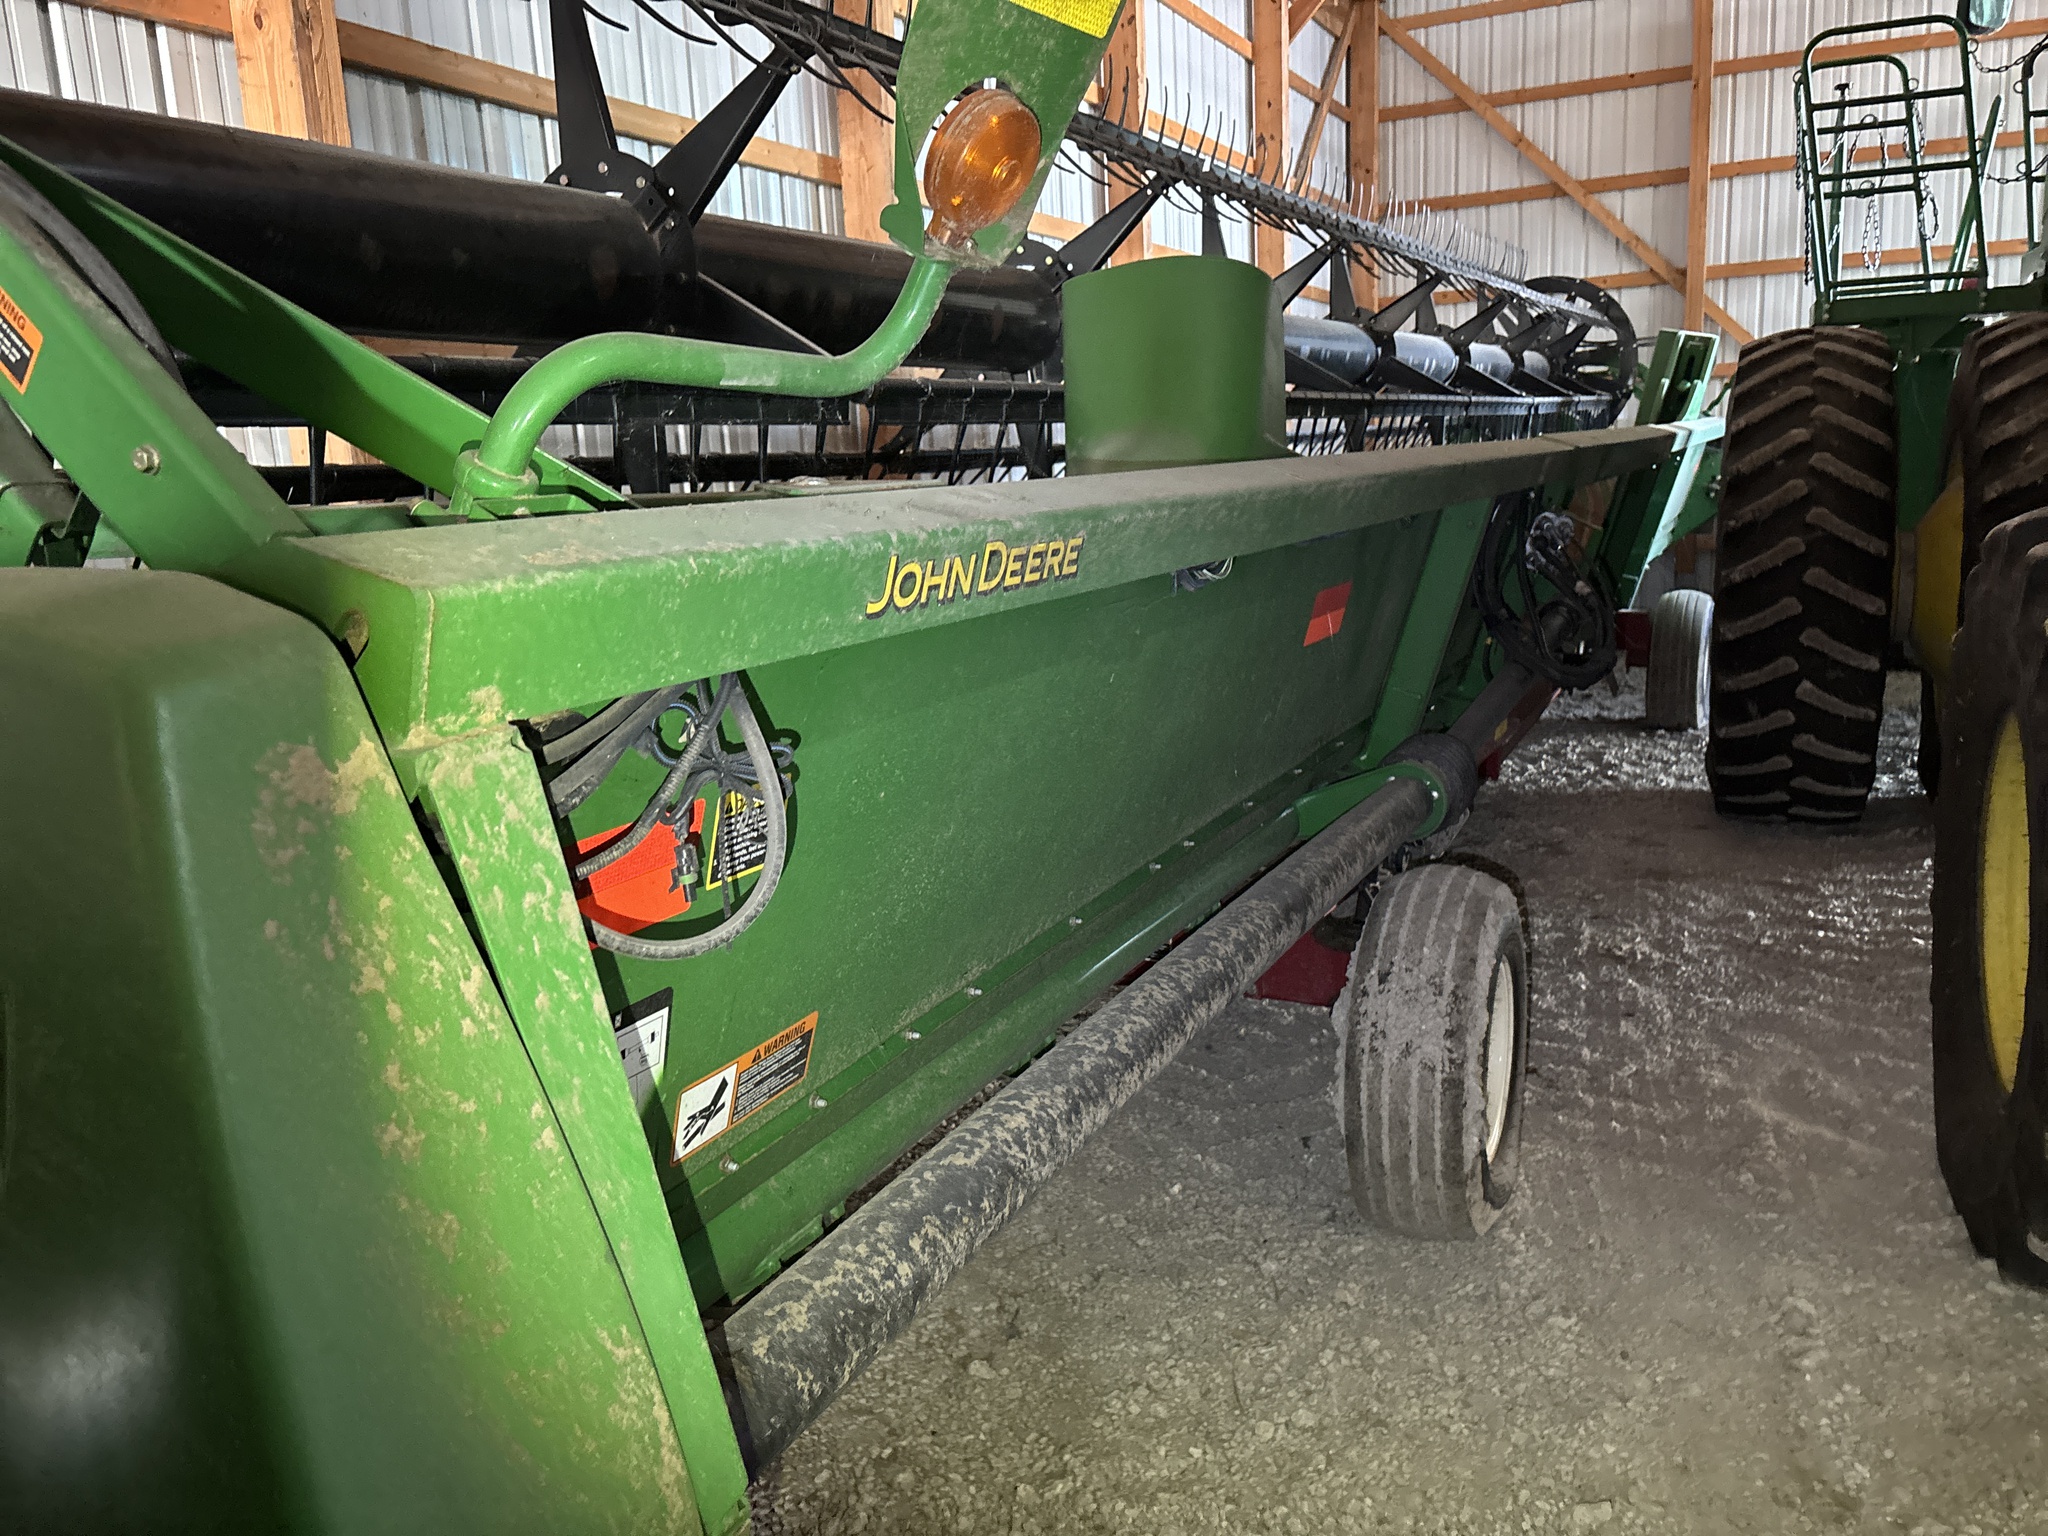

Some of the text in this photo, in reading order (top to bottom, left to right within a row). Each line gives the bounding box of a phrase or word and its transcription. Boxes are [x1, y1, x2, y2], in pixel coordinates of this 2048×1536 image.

[0, 291, 26, 331] NING
[865, 537, 1085, 619] JOHN DEERE
[764, 1021, 806, 1056] WARNING
